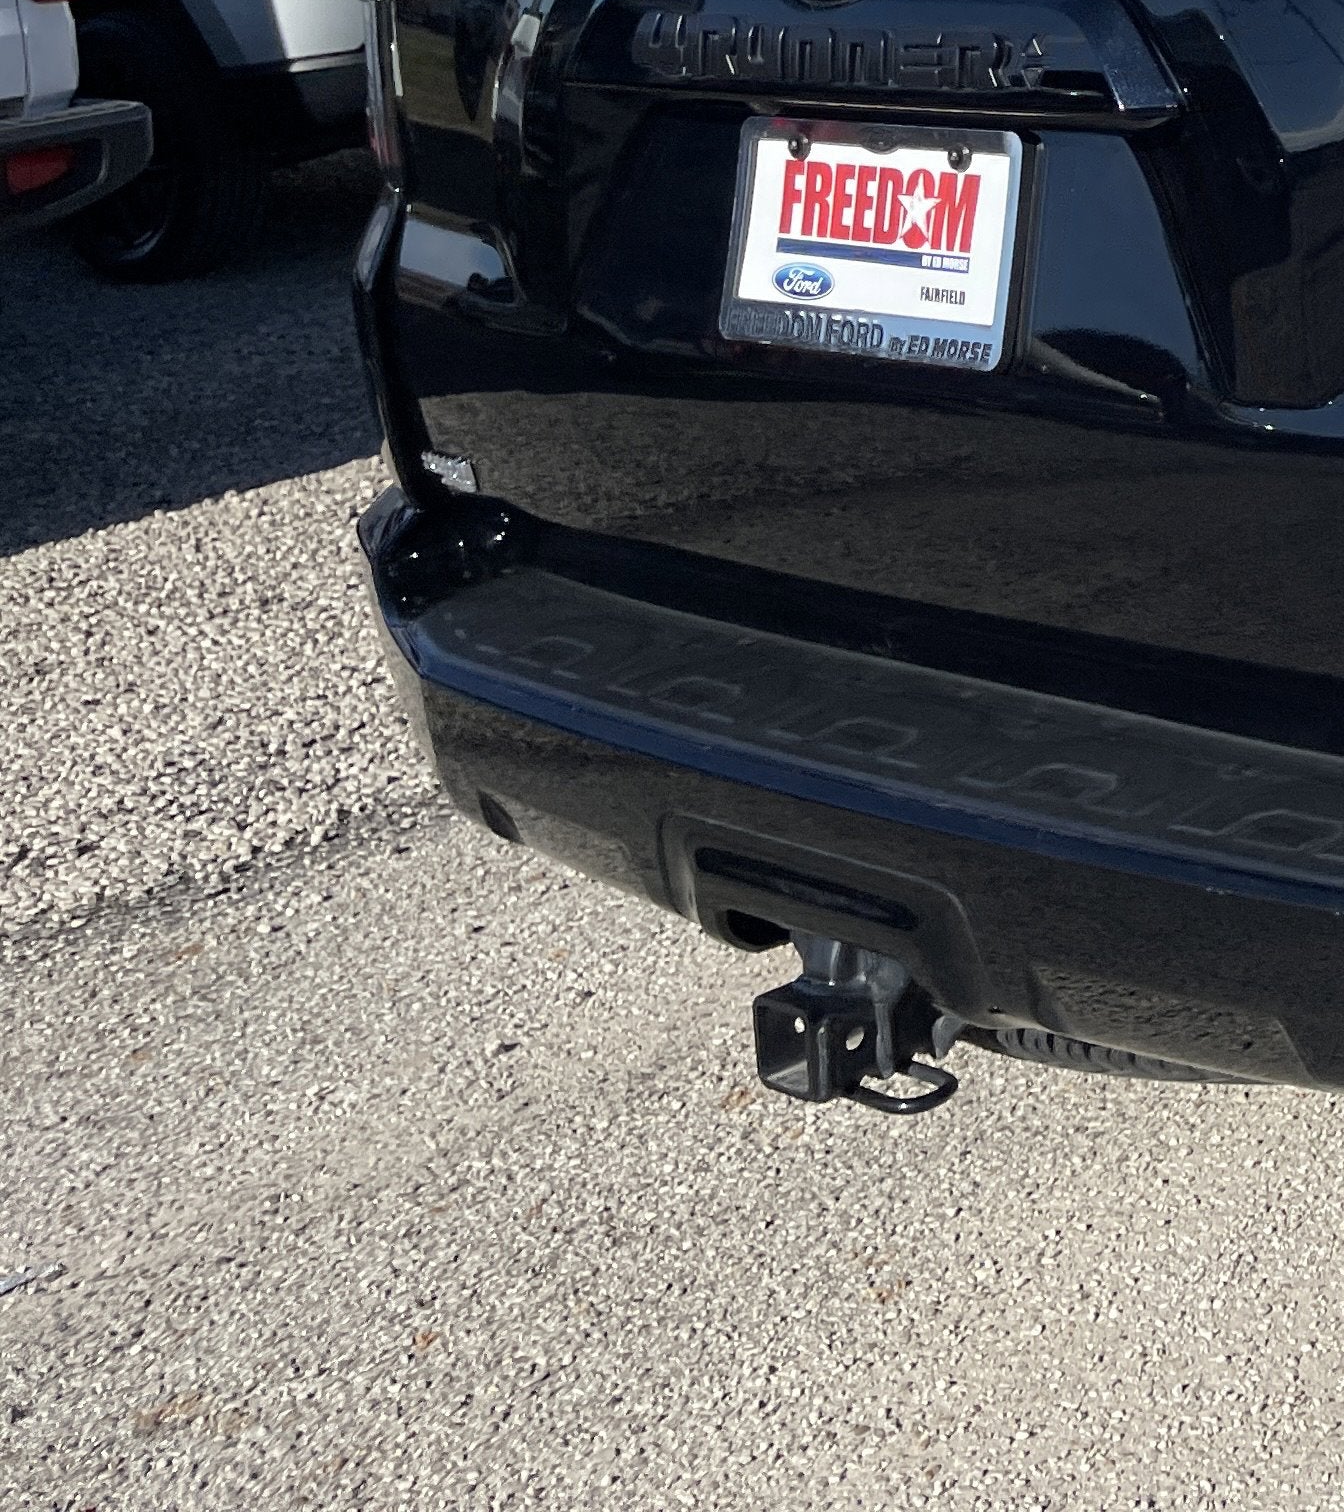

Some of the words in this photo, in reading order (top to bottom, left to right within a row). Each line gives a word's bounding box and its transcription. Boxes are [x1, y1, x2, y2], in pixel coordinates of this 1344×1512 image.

[778, 159, 982, 254] FREEDOM
[782, 265, 824, 295] Ford
[919, 285, 966, 306] FAIRFIELD
[826, 313, 885, 350] FORD
[907, 334, 930, 356] ED
[931, 337, 993, 364] MORSE
